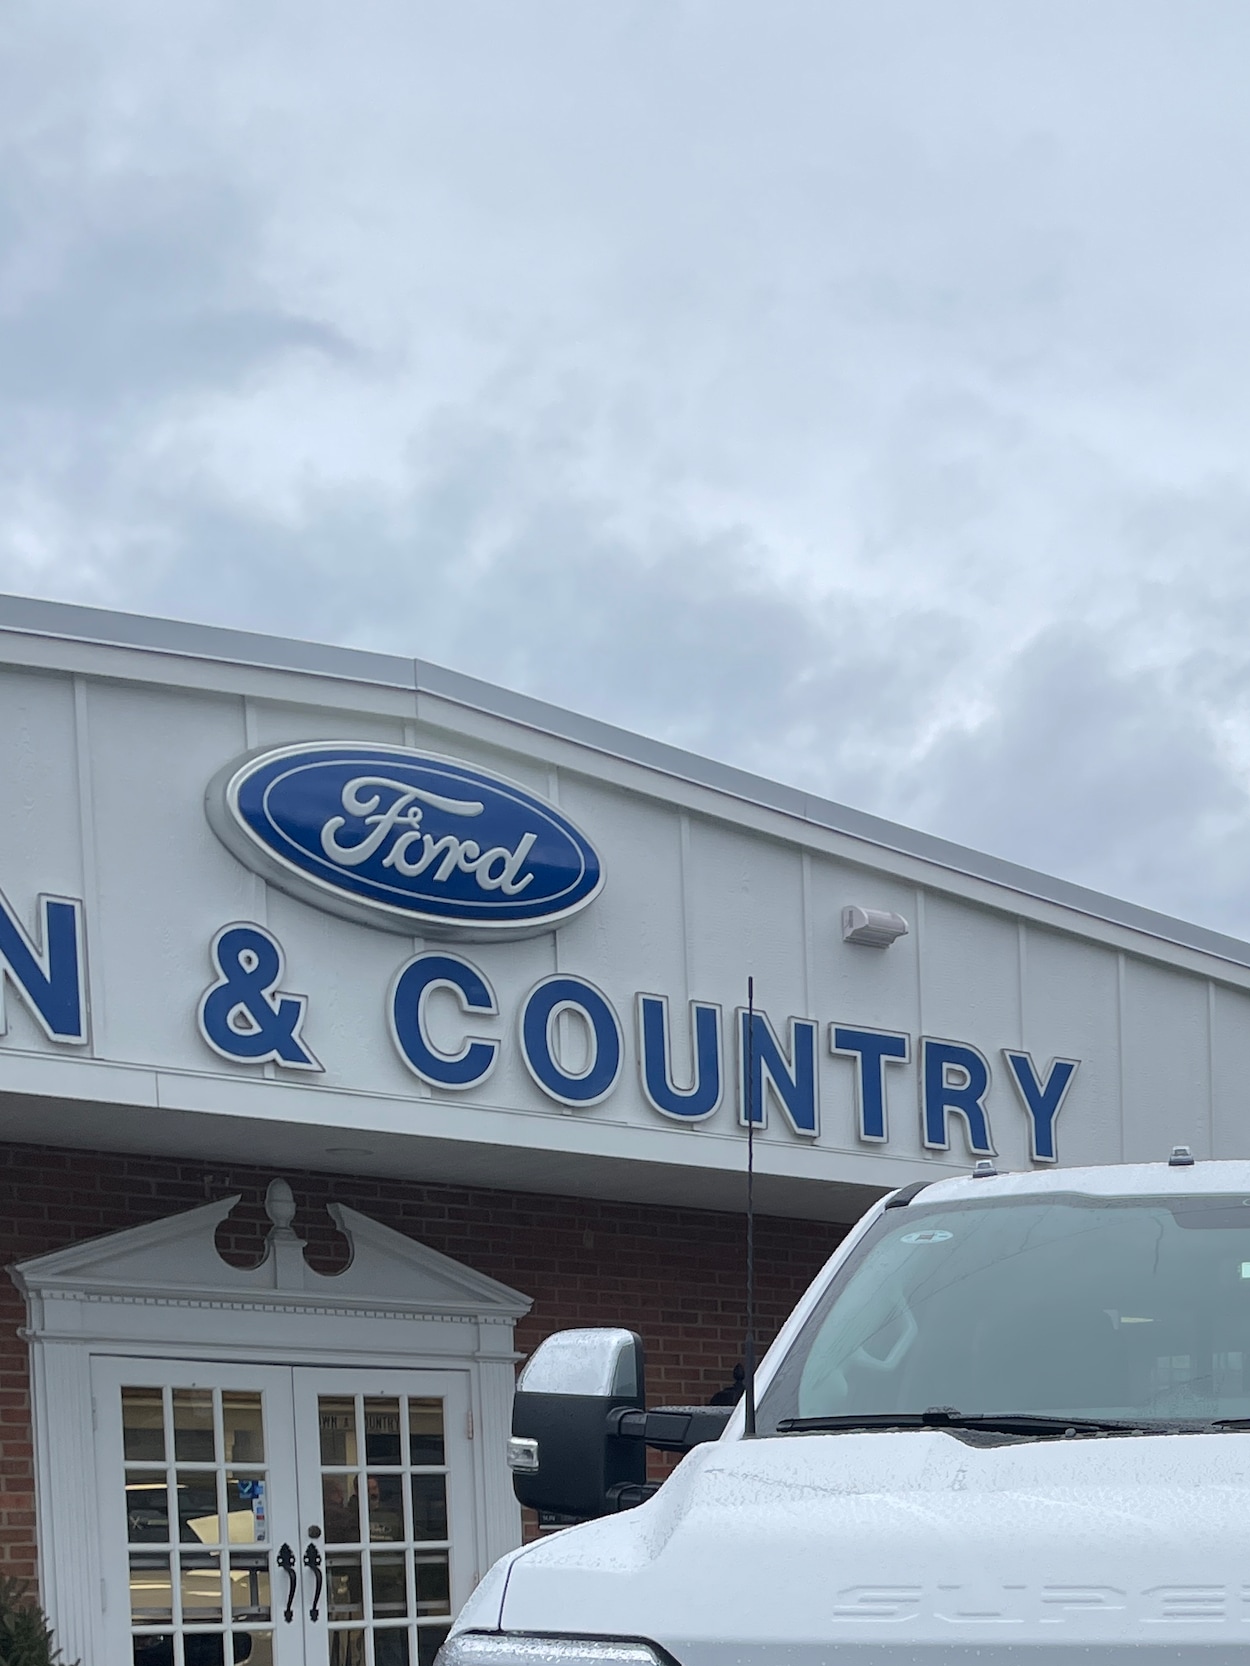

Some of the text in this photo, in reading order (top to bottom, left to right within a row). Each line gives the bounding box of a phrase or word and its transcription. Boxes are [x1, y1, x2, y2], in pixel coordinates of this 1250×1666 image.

[321, 776, 538, 895] Ford
[199, 920, 325, 1072] &
[387, 950, 1081, 1163] COUNTRY
